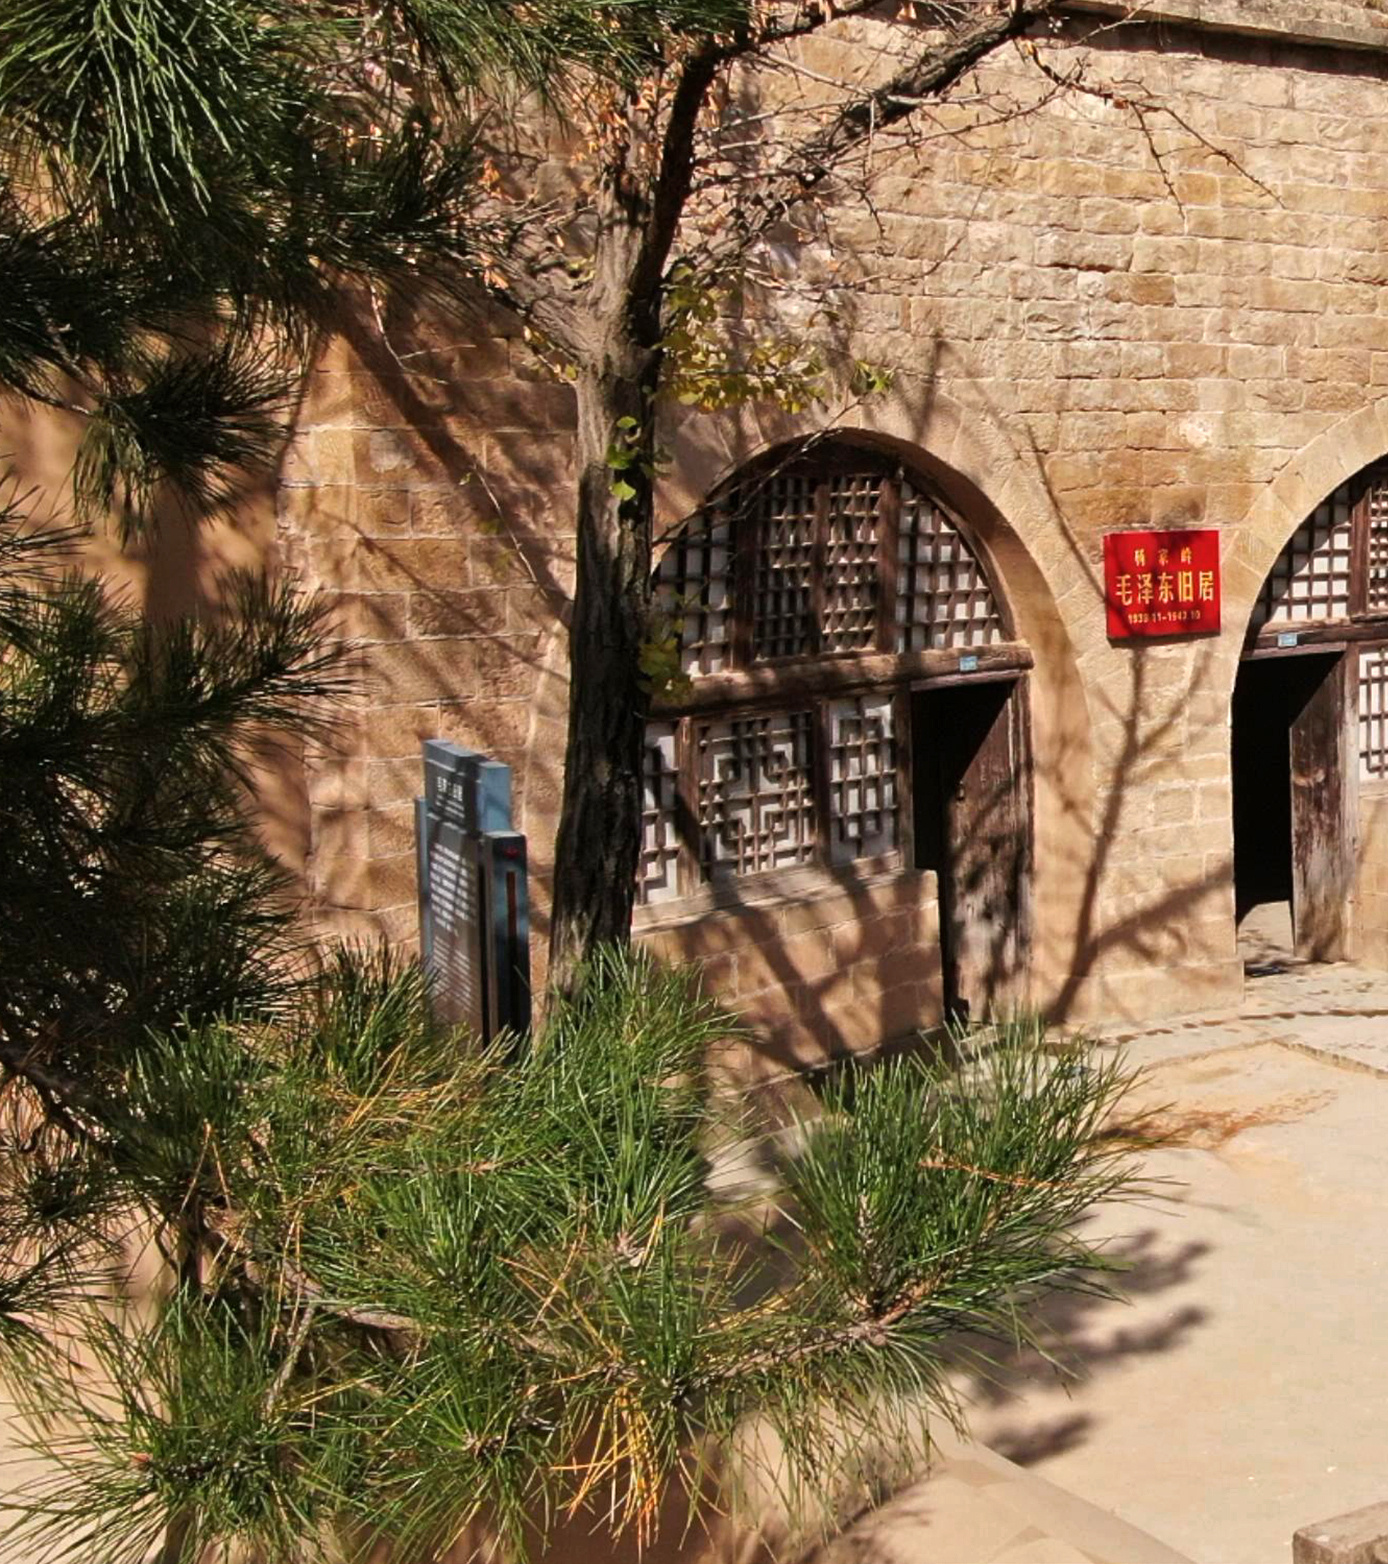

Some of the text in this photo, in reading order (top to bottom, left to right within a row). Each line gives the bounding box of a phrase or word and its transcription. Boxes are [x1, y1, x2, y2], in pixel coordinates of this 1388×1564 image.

[1115, 570, 1214, 606] 毛泽东旧居
